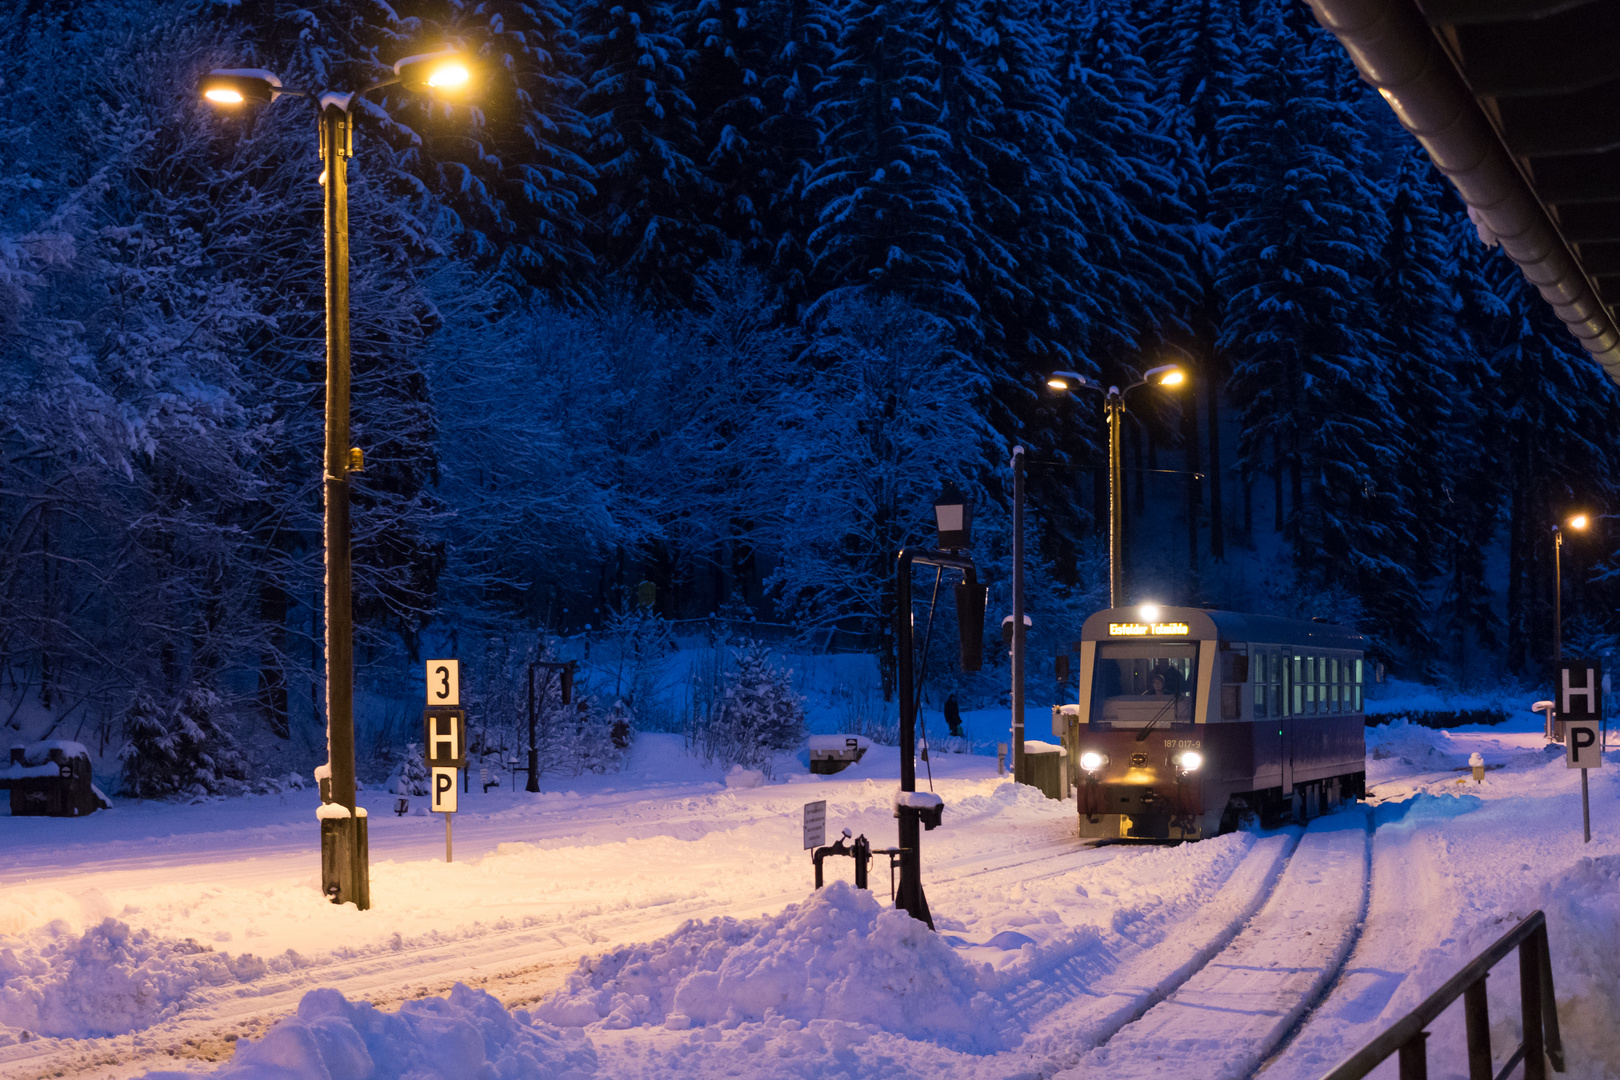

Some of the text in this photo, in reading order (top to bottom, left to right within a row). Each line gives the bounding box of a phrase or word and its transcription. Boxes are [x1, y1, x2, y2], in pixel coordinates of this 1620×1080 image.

[1109, 623, 1148, 635] Eisfelder
[435, 666, 450, 699] 3
[1562, 668, 1595, 713] H
[429, 717, 459, 760] H
[1163, 740, 1201, 749] 187 017-9
[1571, 727, 1595, 762] P
[436, 773, 452, 806] P
